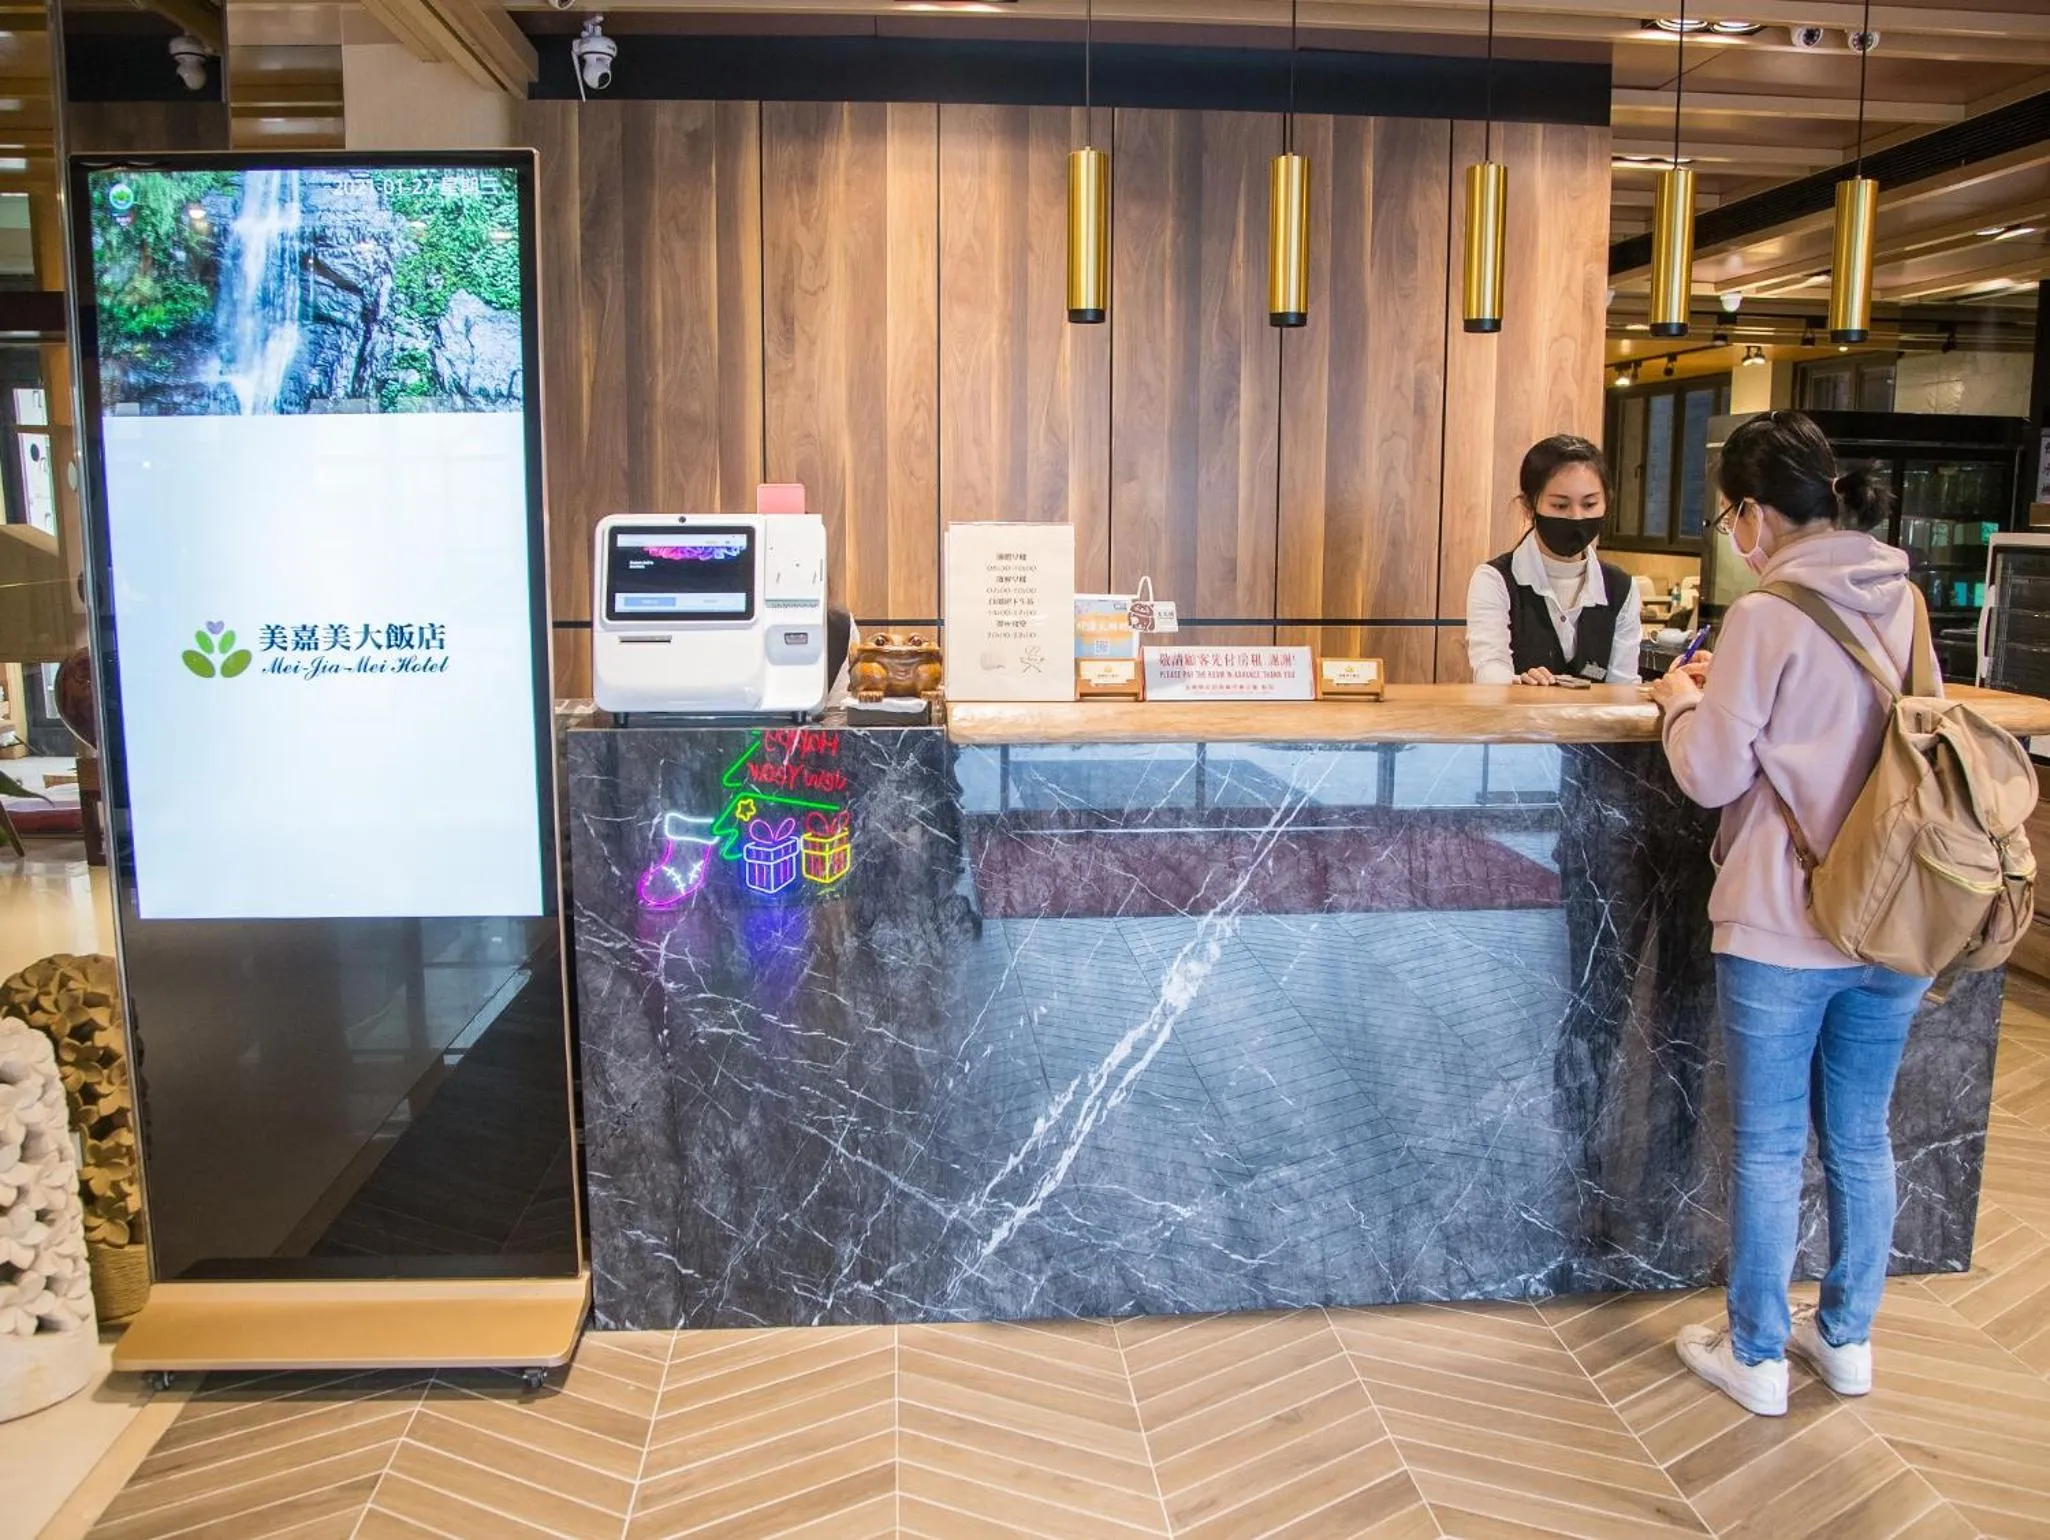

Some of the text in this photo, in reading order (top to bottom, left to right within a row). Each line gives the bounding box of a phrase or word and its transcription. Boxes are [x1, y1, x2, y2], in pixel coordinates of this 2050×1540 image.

[259, 622, 446, 652] 美嘉美大飯店
[262, 655, 450, 680] Mei-Jia-Mei Hotel
